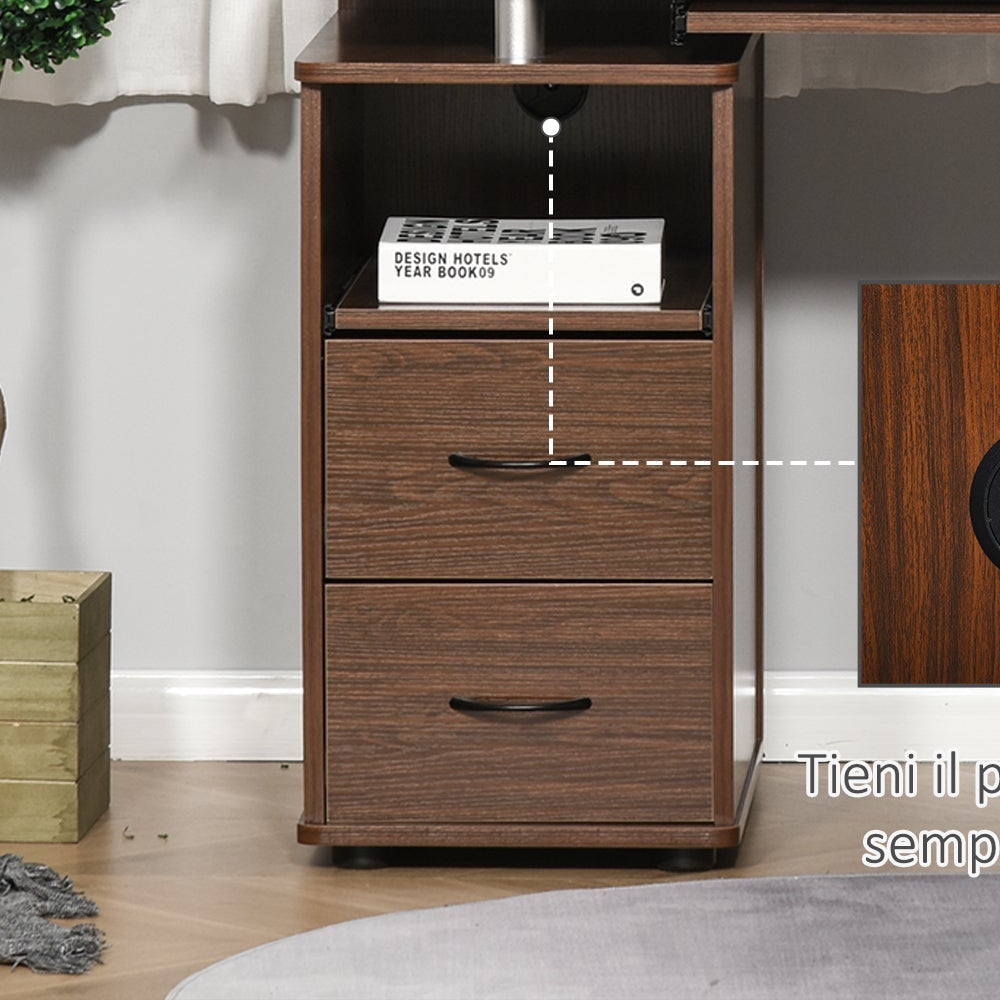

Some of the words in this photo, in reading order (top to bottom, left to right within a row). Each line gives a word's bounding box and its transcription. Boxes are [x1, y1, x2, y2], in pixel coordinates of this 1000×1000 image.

[394, 251, 447, 265] DESIGN
[453, 252, 509, 266] HOTELS
[394, 265, 432, 278] YEAR
[438, 265, 496, 279] BOOK09
